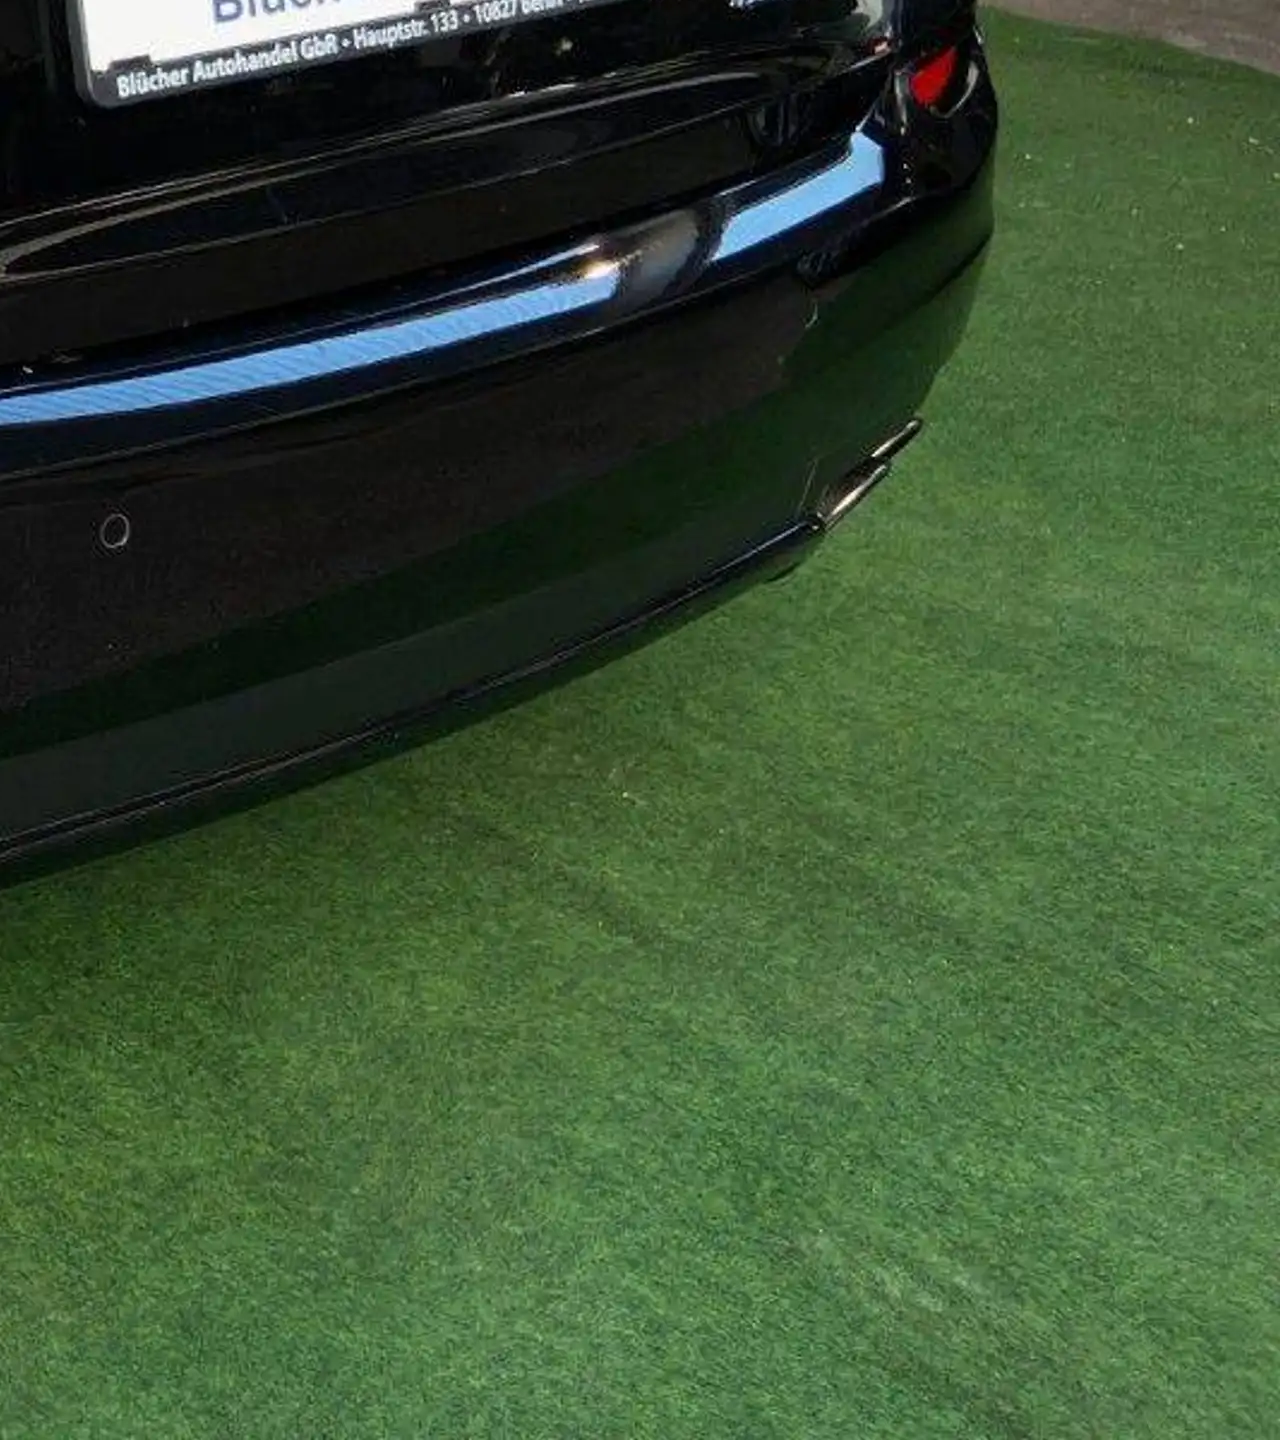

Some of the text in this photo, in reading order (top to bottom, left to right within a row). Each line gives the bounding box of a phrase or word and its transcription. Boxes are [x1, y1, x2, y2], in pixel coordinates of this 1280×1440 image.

[115, 66, 188, 98] Blücher
[193, 39, 298, 84] Autohandel
[352, 14, 428, 49] Hauptstr.
[432, 10, 458, 34] 133
